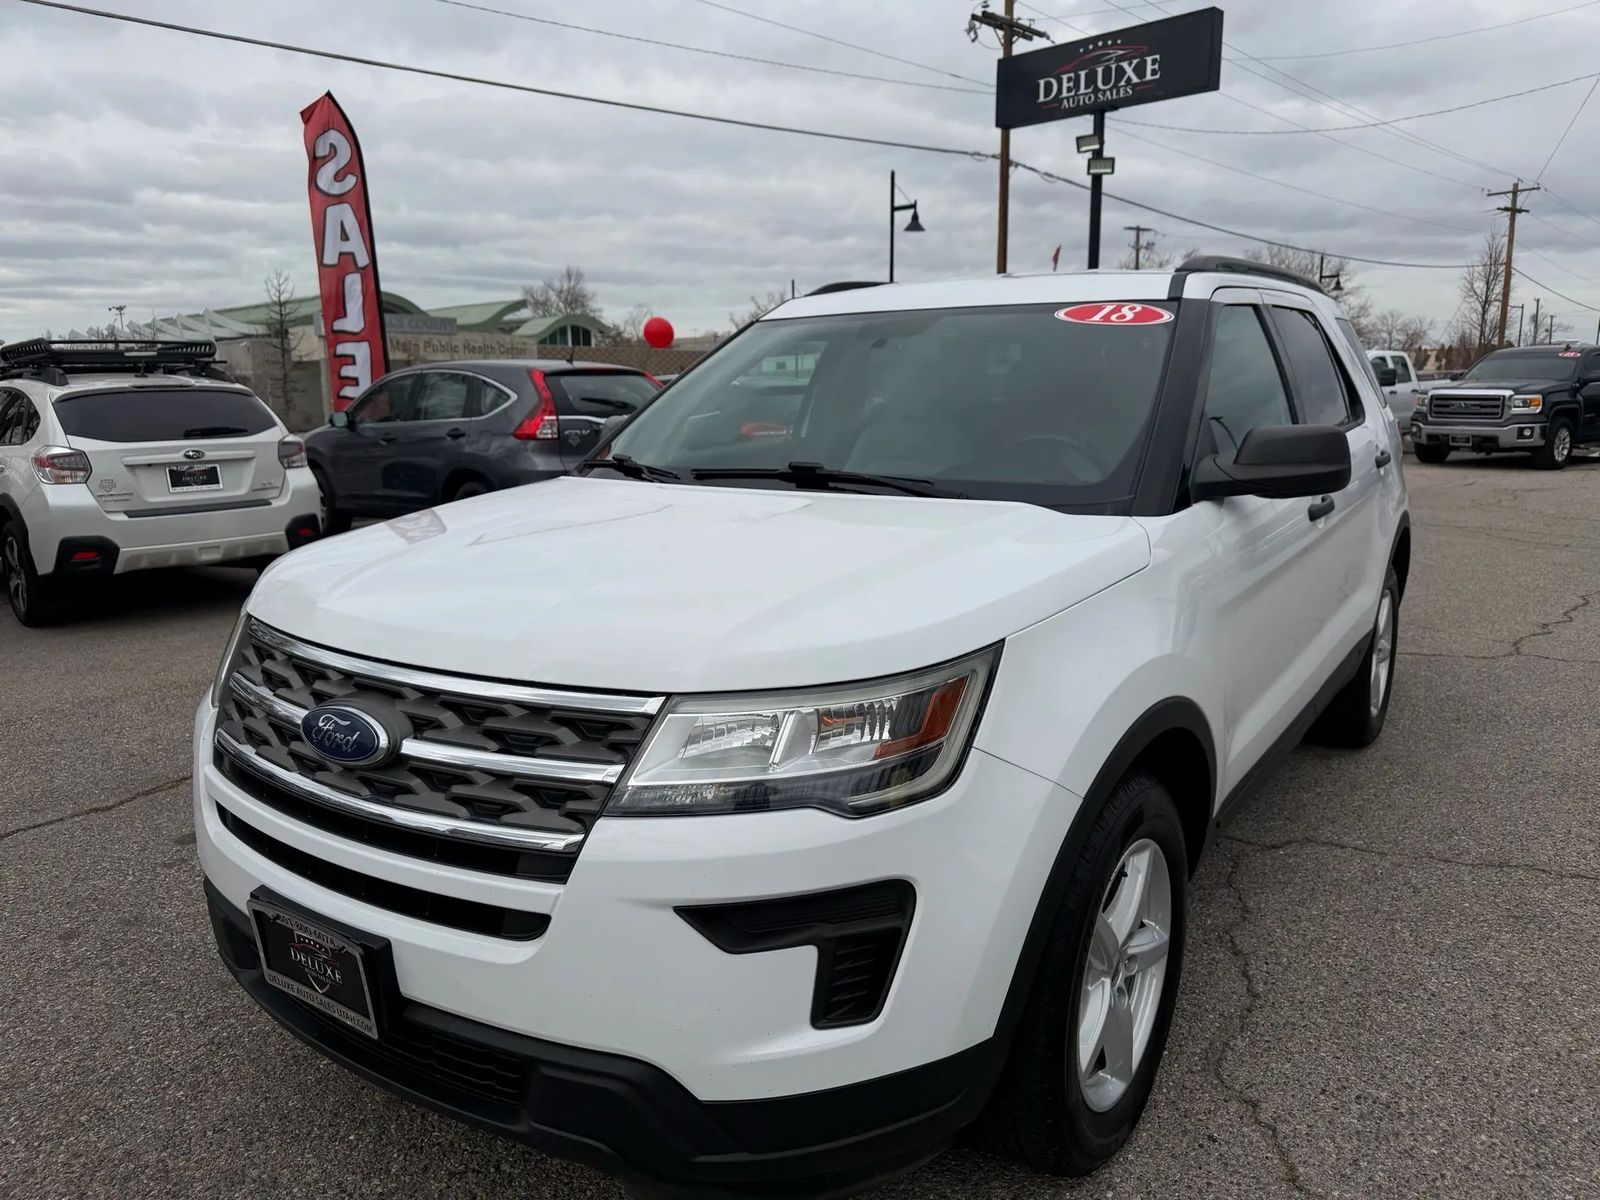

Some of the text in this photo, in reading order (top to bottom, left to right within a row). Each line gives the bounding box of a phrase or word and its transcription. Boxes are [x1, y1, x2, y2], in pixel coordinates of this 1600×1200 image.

[1036, 54, 1161, 103] DELUXE
[1061, 85, 1133, 109] AUTO SALES
[390, 338, 421, 354] Main
[424, 338, 459, 354] Public
[463, 339, 497, 355] Health
[312, 713, 361, 753] Ford
[290, 947, 343, 985] DELUXE
[268, 973, 296, 993] DELUXE
